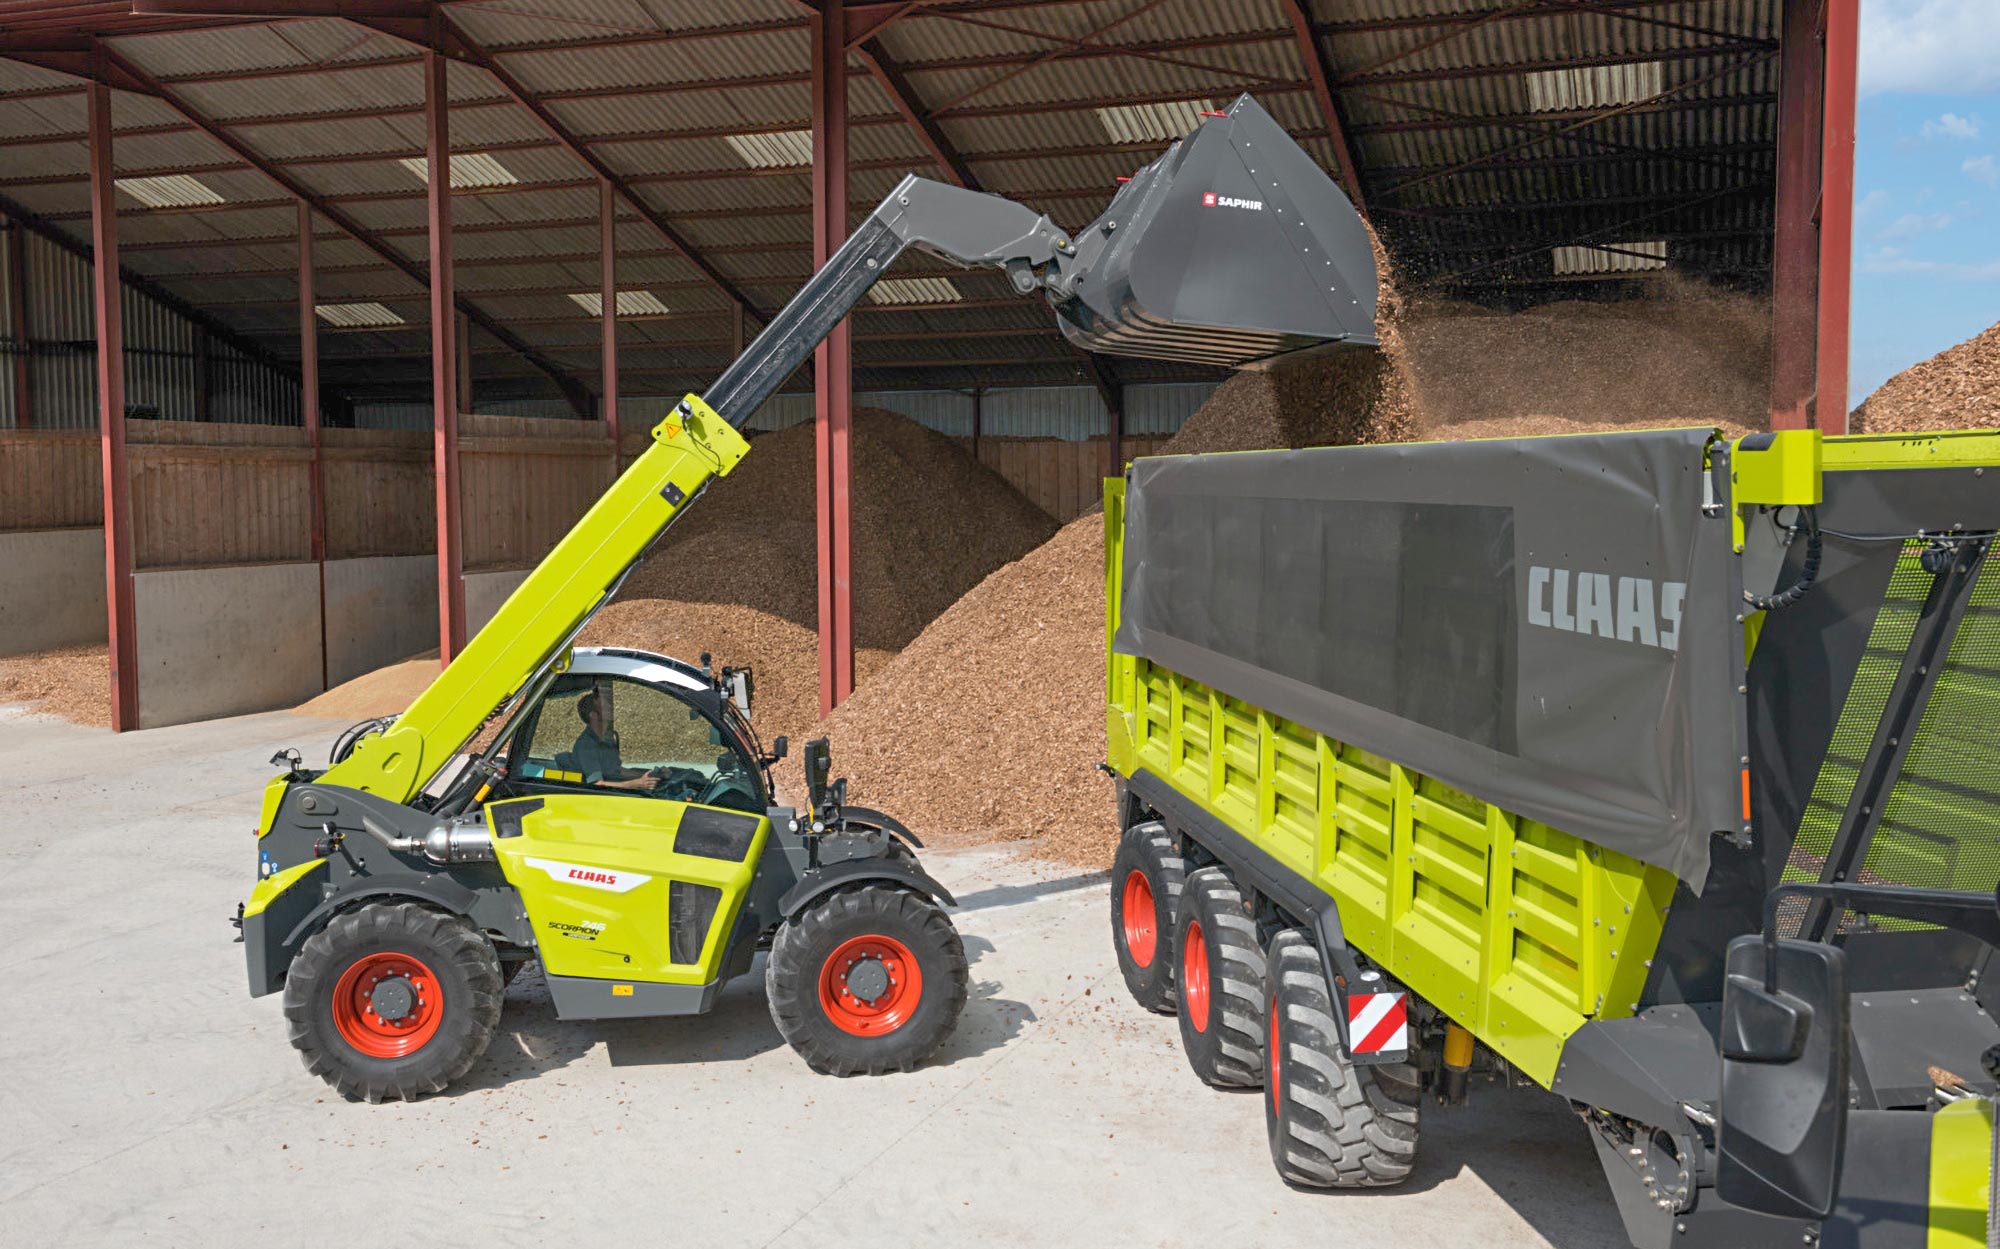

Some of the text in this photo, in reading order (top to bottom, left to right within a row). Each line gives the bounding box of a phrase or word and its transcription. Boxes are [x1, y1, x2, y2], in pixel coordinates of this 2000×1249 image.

[1217, 196, 1263, 211] SAPHIR
[1528, 565, 1687, 651] CLAAS
[568, 868, 617, 885] CLAAS
[548, 921, 600, 936] SCORPION
